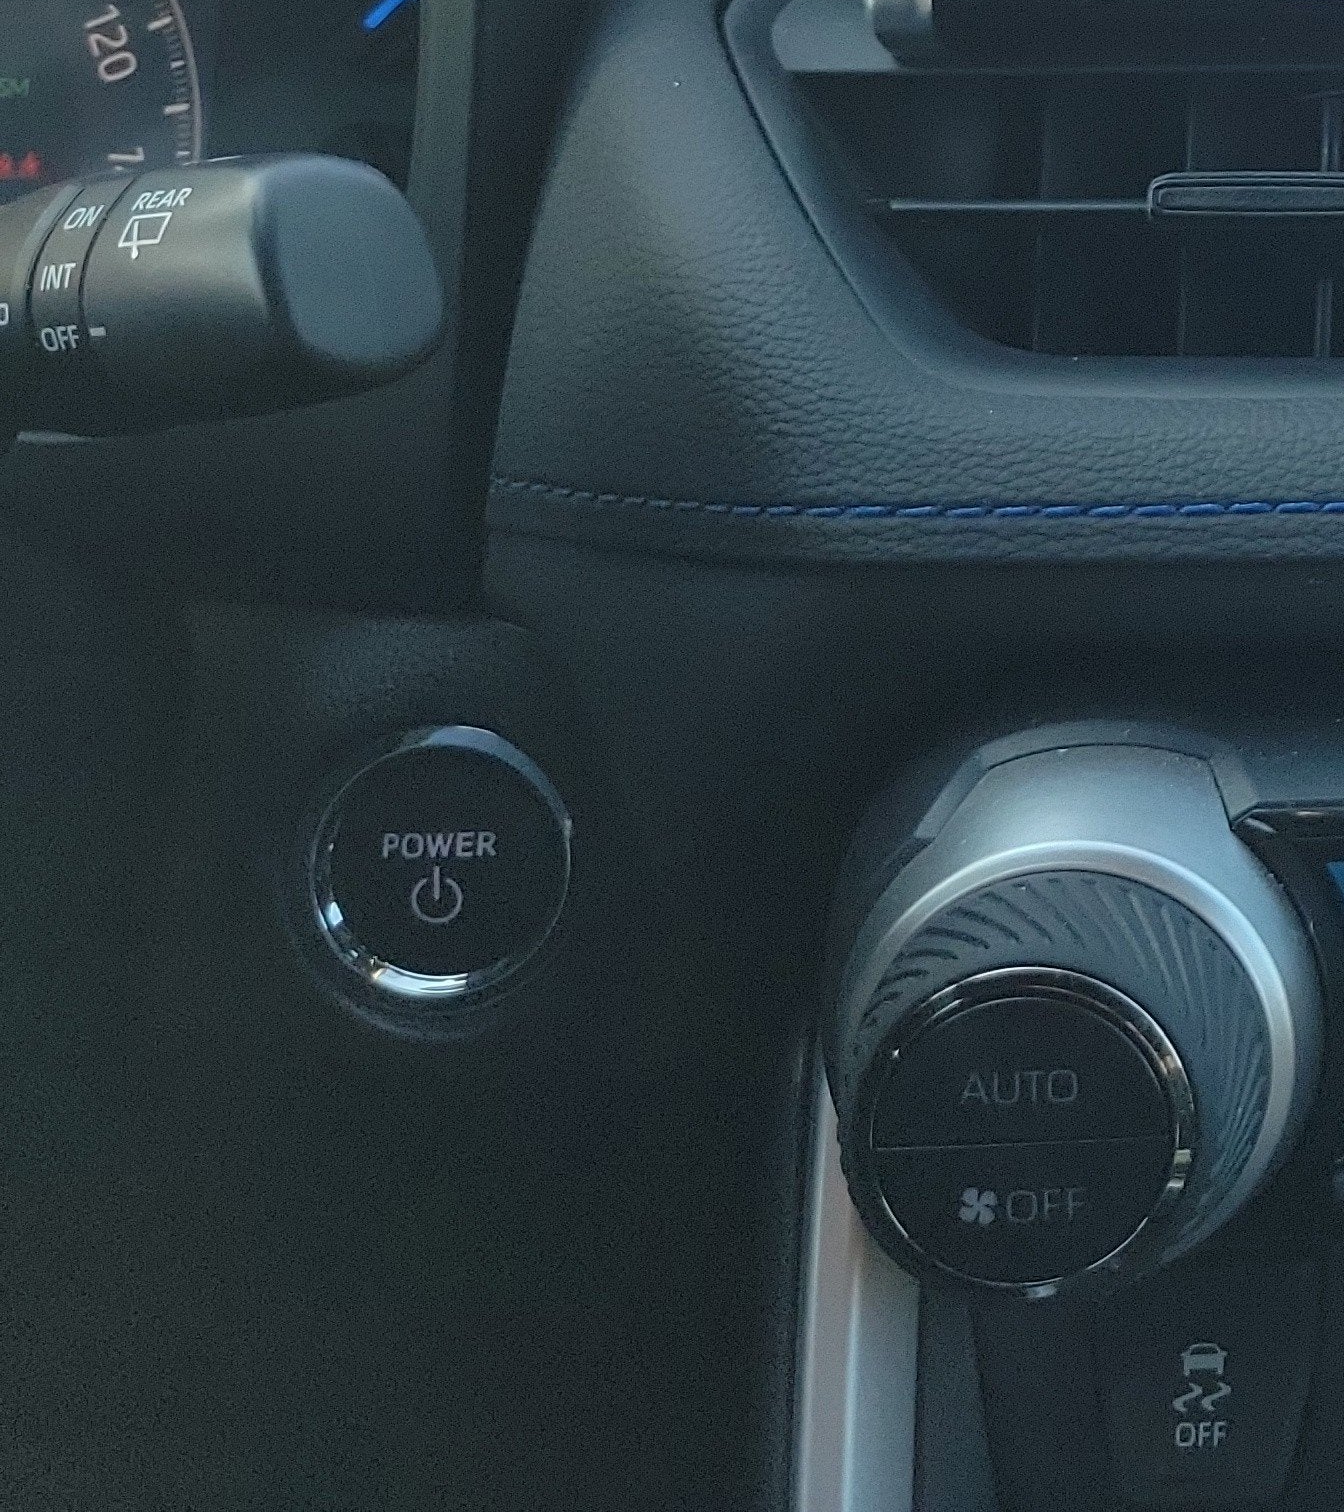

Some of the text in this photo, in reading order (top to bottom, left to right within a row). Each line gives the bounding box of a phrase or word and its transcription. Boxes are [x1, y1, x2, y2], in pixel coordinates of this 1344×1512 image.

[84, 3, 138, 84] 120
[131, 187, 193, 212] REAR
[63, 204, 105, 230] ON
[40, 262, 77, 291] INT
[40, 325, 79, 352] OFF
[382, 830, 497, 859] POWER
[960, 1069, 1079, 1105] AUTO
[1005, 1187, 1085, 1223] OFF
[1175, 1420, 1228, 1448] OFF
